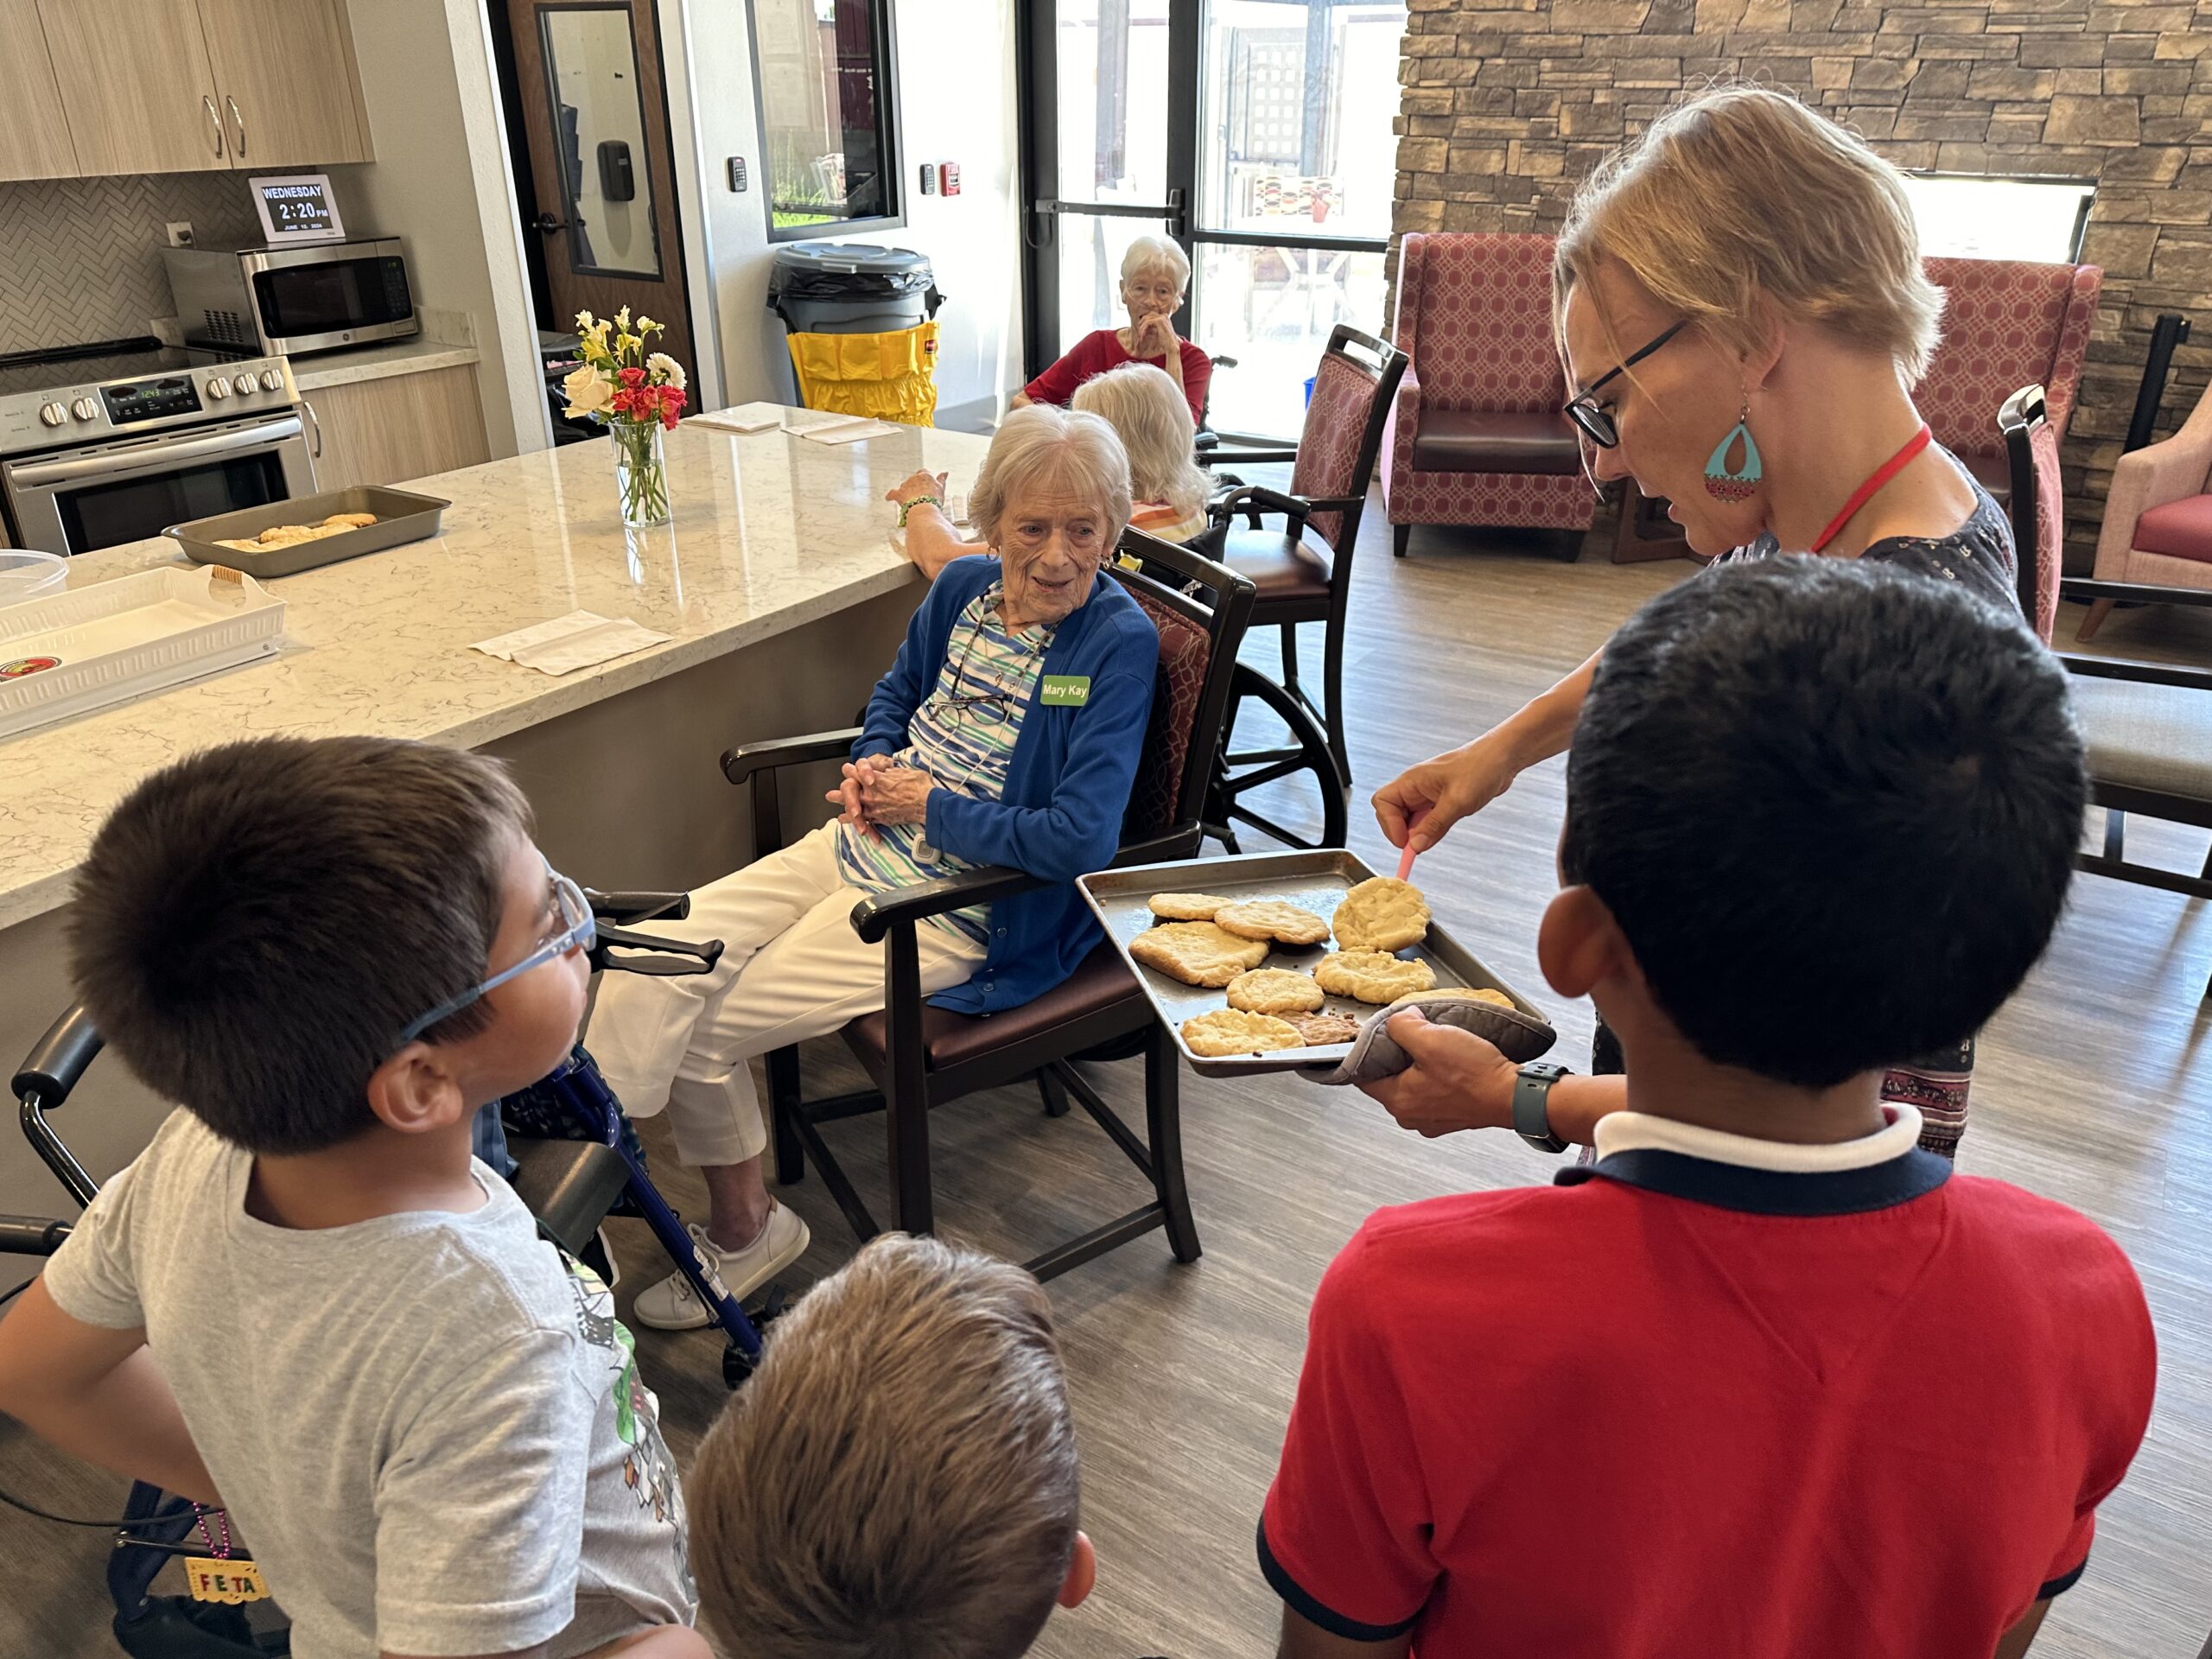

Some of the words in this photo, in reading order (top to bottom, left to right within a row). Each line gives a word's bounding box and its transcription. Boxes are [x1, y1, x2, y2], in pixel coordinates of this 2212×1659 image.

[262, 185, 321, 199] WEDNESDAY
[279, 202, 315, 219] 2:20
[315, 209, 328, 218] PM
[1043, 683, 1066, 698] Mary
[1068, 684, 1088, 699] Kay
